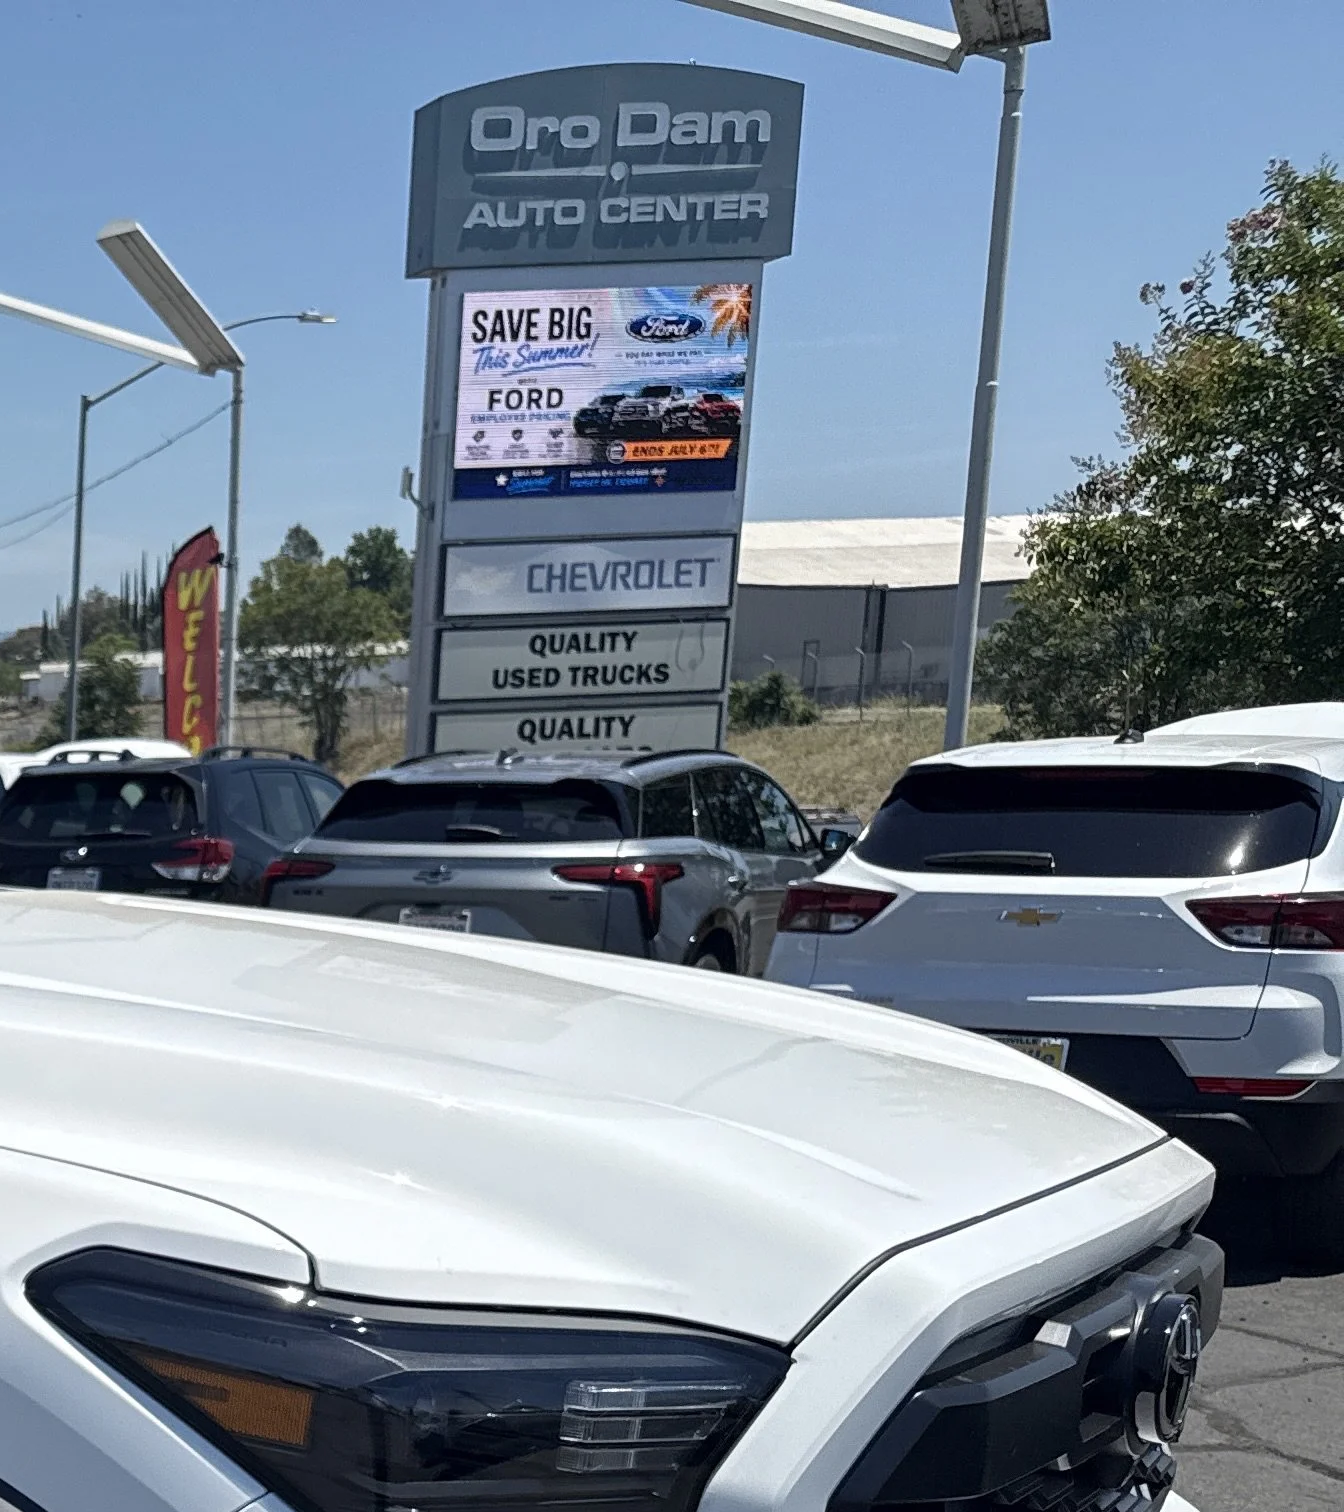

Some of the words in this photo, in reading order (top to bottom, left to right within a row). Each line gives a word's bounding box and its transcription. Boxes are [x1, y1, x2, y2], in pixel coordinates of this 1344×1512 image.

[470, 106, 600, 151] Oro
[617, 102, 771, 146] Dam
[463, 199, 585, 228] AUTO
[600, 193, 769, 224] CENTER
[471, 308, 540, 343] SAVE
[548, 306, 592, 340] BIG
[641, 316, 690, 337] Ford
[473, 346, 510, 374] This
[512, 333, 600, 368] Summer!
[488, 388, 563, 411] FORD
[527, 558, 716, 593] CHEVROLET
[529, 631, 638, 658] QUALITY
[492, 667, 560, 690] USED
[568, 663, 670, 687] TRUCKS
[517, 715, 636, 745] QUALITY
